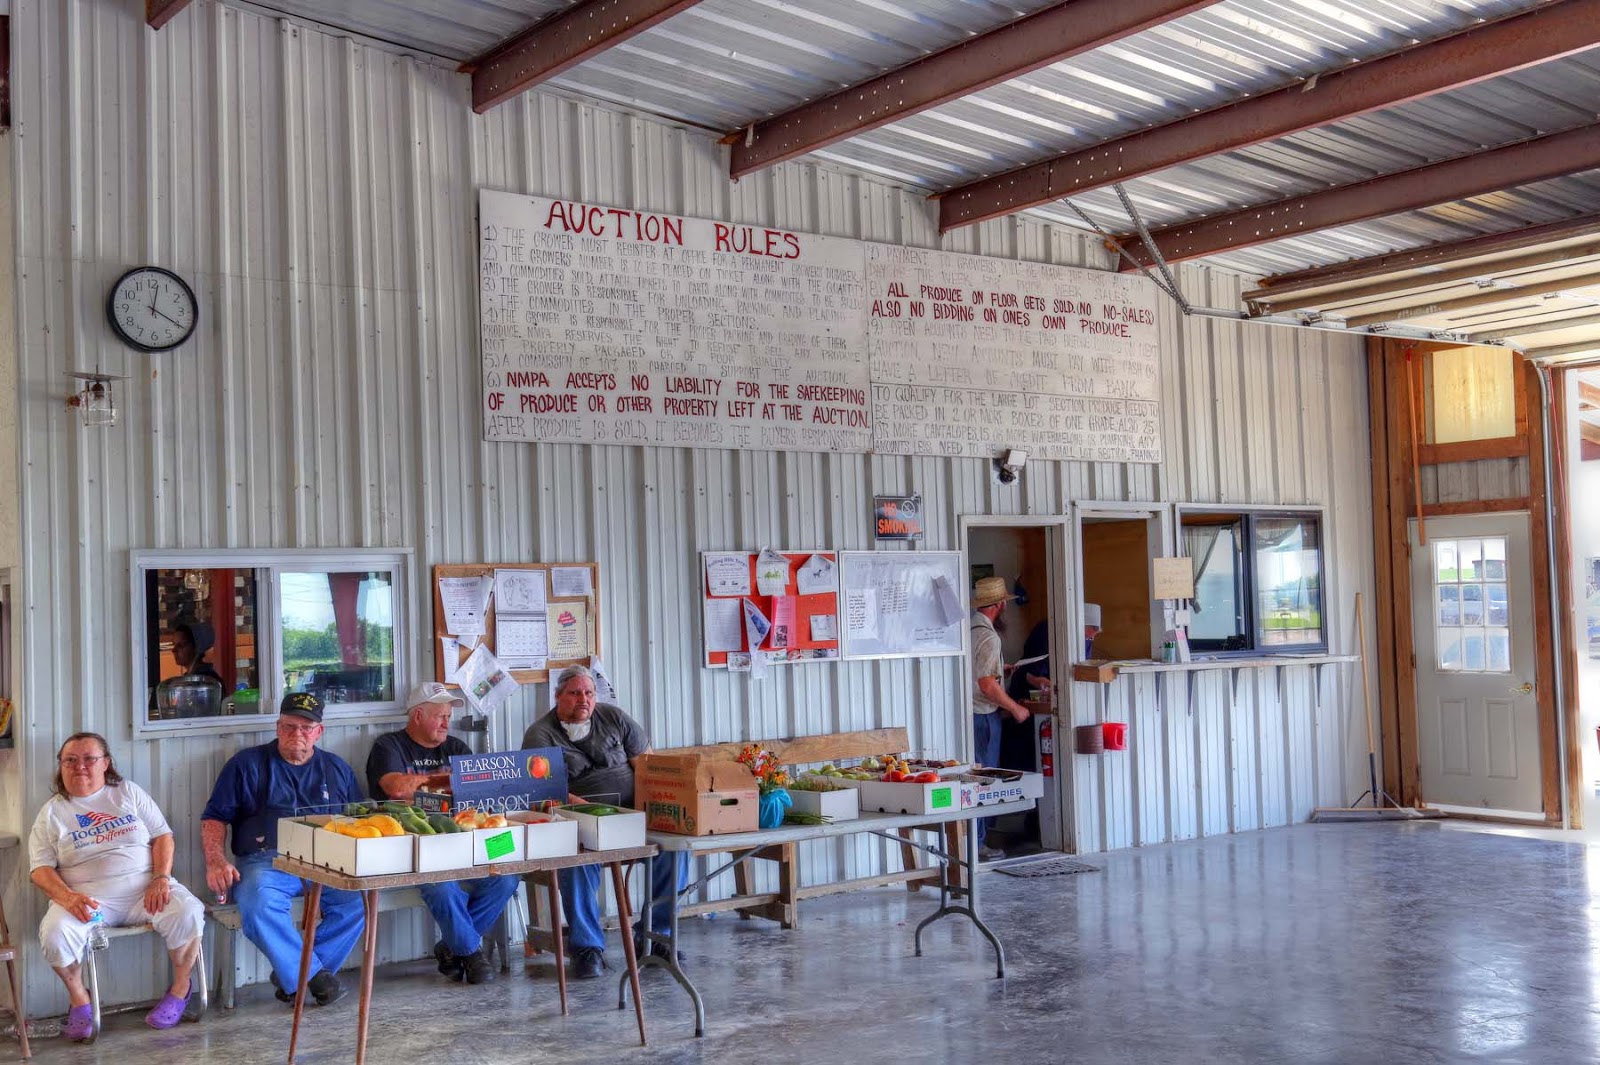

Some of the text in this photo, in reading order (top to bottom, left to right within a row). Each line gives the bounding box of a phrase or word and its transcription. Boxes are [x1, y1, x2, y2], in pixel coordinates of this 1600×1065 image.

[544, 201, 801, 259] AUCTION RULES
[484, 225, 497, 241] 1)
[503, 227, 525, 245] THE
[534, 231, 573, 250] GROWER
[581, 237, 609, 253] MUST
[616, 242, 656, 258] REGISTER
[663, 247, 674, 261] AT
[482, 262, 502, 276] AND
[510, 264, 564, 280] COMMODITIES
[483, 244, 497, 260] 2)
[502, 245, 523, 262] THE
[530, 249, 571, 267] GROWERS
[699, 268, 711, 279] ON
[781, 277, 800, 289] WITH
[807, 279, 822, 292] THE
[136, 282, 142, 291] 11
[148, 279, 158, 289] 12
[166, 284, 168, 293] 1
[483, 277, 495, 291] 3)
[500, 277, 519, 293] THE
[528, 280, 564, 295] GROWER
[572, 284, 579, 297] IS
[125, 290, 135, 300] 10
[174, 293, 180, 303] 2
[122, 304, 129, 313] 9
[178, 307, 185, 317] 3
[498, 295, 519, 310] THE
[529, 296, 593, 314] COMMODITIES
[610, 302, 619, 316] IN
[625, 304, 645, 318] THE
[657, 306, 694, 323] PROPER
[888, 282, 910, 297] ALL
[920, 284, 963, 302] PRODUCE
[972, 290, 983, 305] ON
[990, 292, 1018, 308] FLOOR
[1024, 296, 1045, 311] GETS
[1103, 304, 1154, 326] NO-SALES)
[127, 316, 134, 326] 8
[500, 309, 518, 323] THE
[526, 311, 559, 324] GROWER
[570, 314, 577, 326] IS
[871, 300, 1131, 338] ALSO NO BIDDING ON ONES OWN PRODUCE.
[137, 324, 144, 337] 7
[151, 331, 158, 341] 6
[165, 329, 172, 338] 5
[485, 338, 505, 351] NOT
[623, 334, 642, 345] THE
[503, 353, 510, 367] A
[507, 371, 865, 406] NMPA ACCEPTS NO LIABILITY FOR THE SAFEKEEPING
[873, 386, 890, 401] TO
[895, 386, 936, 403] QUALIFY
[944, 390, 963, 405] FOR
[967, 391, 986, 406] THE
[1024, 395, 1040, 410] LOT
[1049, 397, 1085, 413] SECTION
[488, 392, 870, 429] OF PRODUCE OR OTHER PROPERTY LEFT AT THE AUCTION.
[875, 404, 1154, 434] BE PACKED IN 2 OR BOXES OF ONE 25
[488, 415, 526, 437] AFTER
[533, 416, 581, 440] PRODUCE
[593, 420, 606, 440] IS
[656, 420, 667, 440] IT
[673, 420, 723, 443] BECOMES
[730, 424, 751, 445] THE
[875, 422, 889, 439] OR
[914, 441, 932, 454] LESS
[940, 440, 963, 454] NEED
[968, 443, 979, 455] TO
[1039, 445, 1047, 457] IN
[884, 502, 896, 517] NO
[460, 756, 515, 772] PEARSON
[492, 768, 521, 780] FARM
[979, 788, 1022, 800] BERRIES
[457, 794, 530, 813] PEARSON
[68, 814, 136, 841] TOGETHER
[96, 825, 137, 844] Difference
